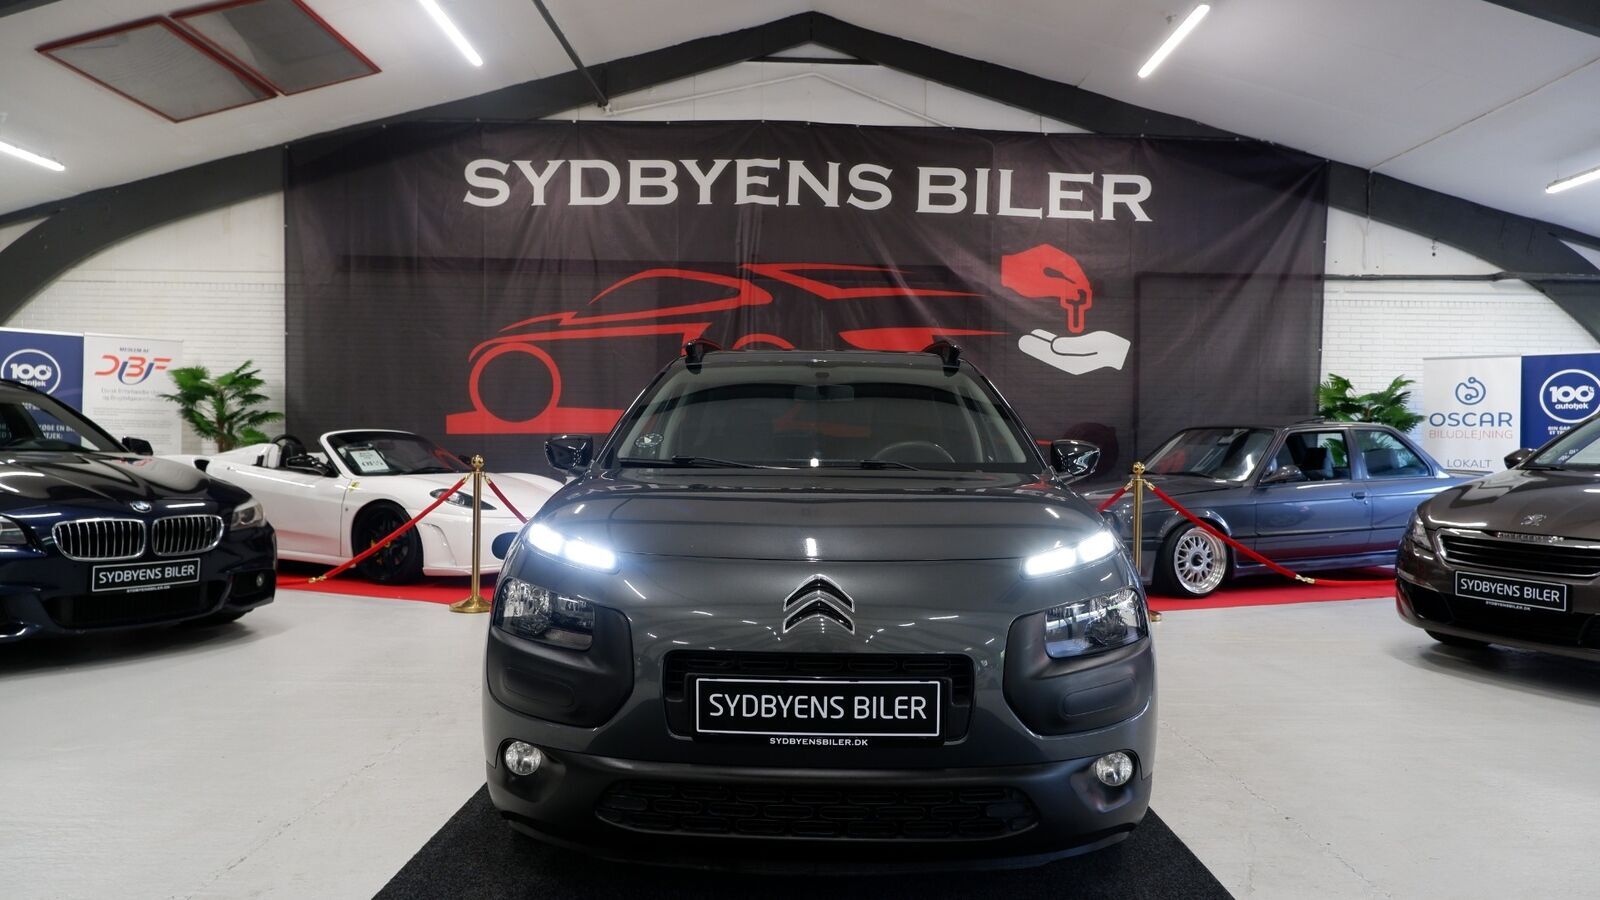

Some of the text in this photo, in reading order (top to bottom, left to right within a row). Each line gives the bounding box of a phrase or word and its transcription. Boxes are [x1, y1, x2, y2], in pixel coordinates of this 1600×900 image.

[463, 158, 1153, 222] SYDBYENS BILER
[1554, 402, 1589, 410] autotjek
[1429, 412, 1513, 427] OSCAR
[1429, 429, 1513, 441] BILUDLEJNING
[1447, 458, 1492, 468] LOKALT
[99, 564, 195, 584] SYDBYENS BILER
[1460, 578, 1560, 603] SYDBYENS BILER
[709, 693, 927, 720] SYDBYENS BILER
[769, 737, 868, 746] SYDBYENSBILER.DK
